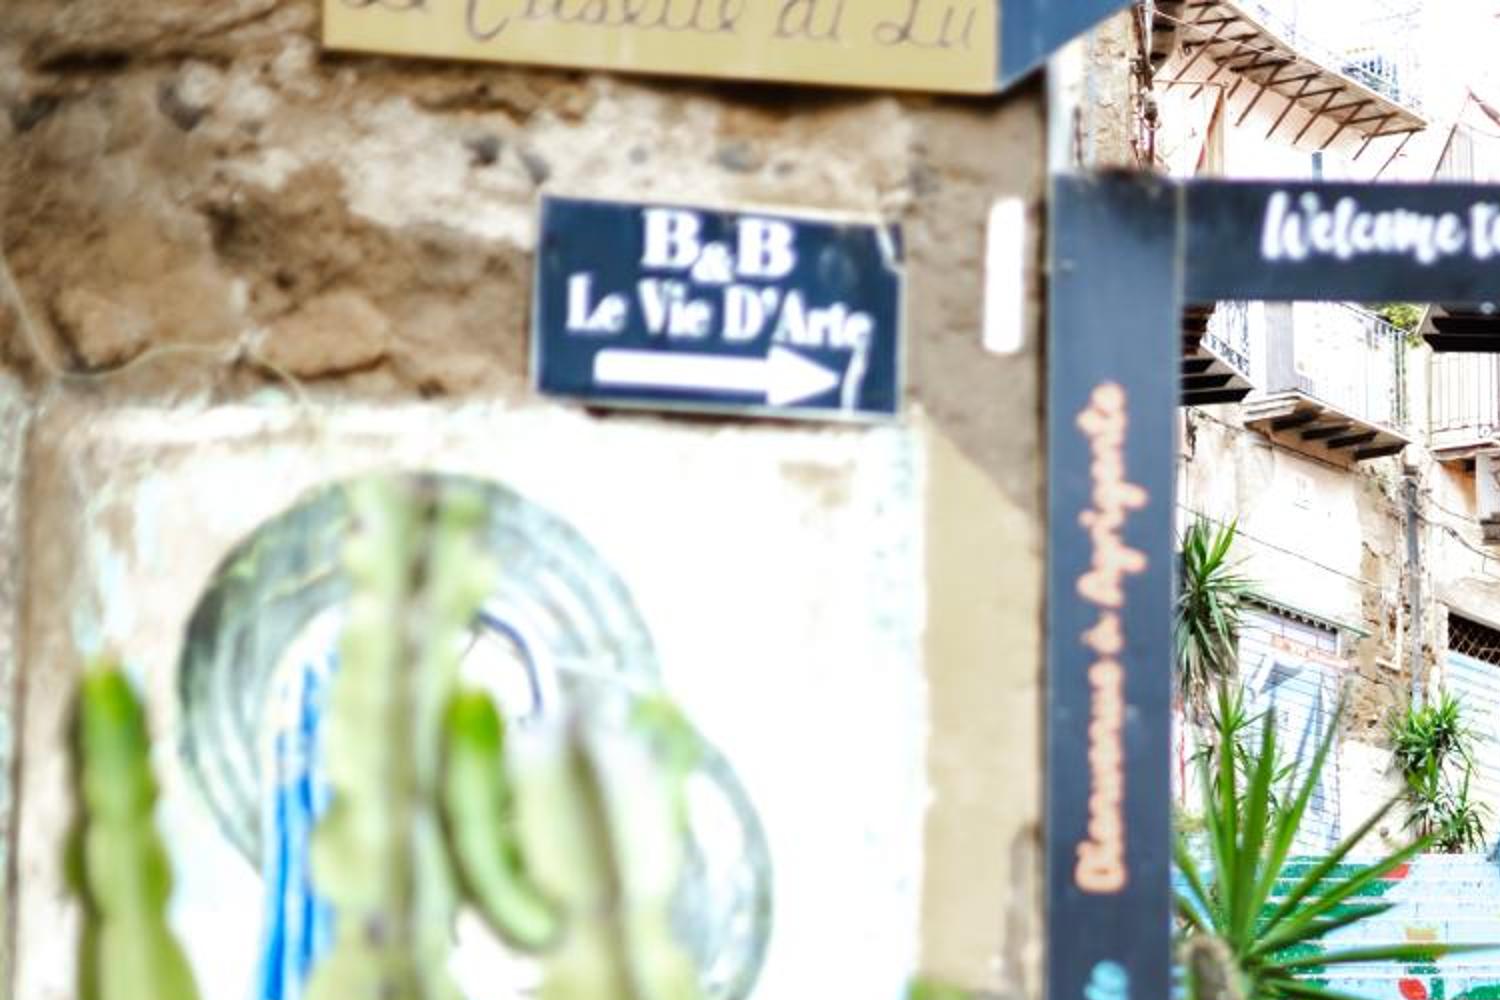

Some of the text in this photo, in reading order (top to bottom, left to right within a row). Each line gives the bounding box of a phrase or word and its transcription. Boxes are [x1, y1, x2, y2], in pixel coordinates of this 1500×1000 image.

[641, 207, 796, 284] B&B
[1261, 190, 1466, 264] Welcome
[567, 272, 874, 349] Le Vie D'Arte
